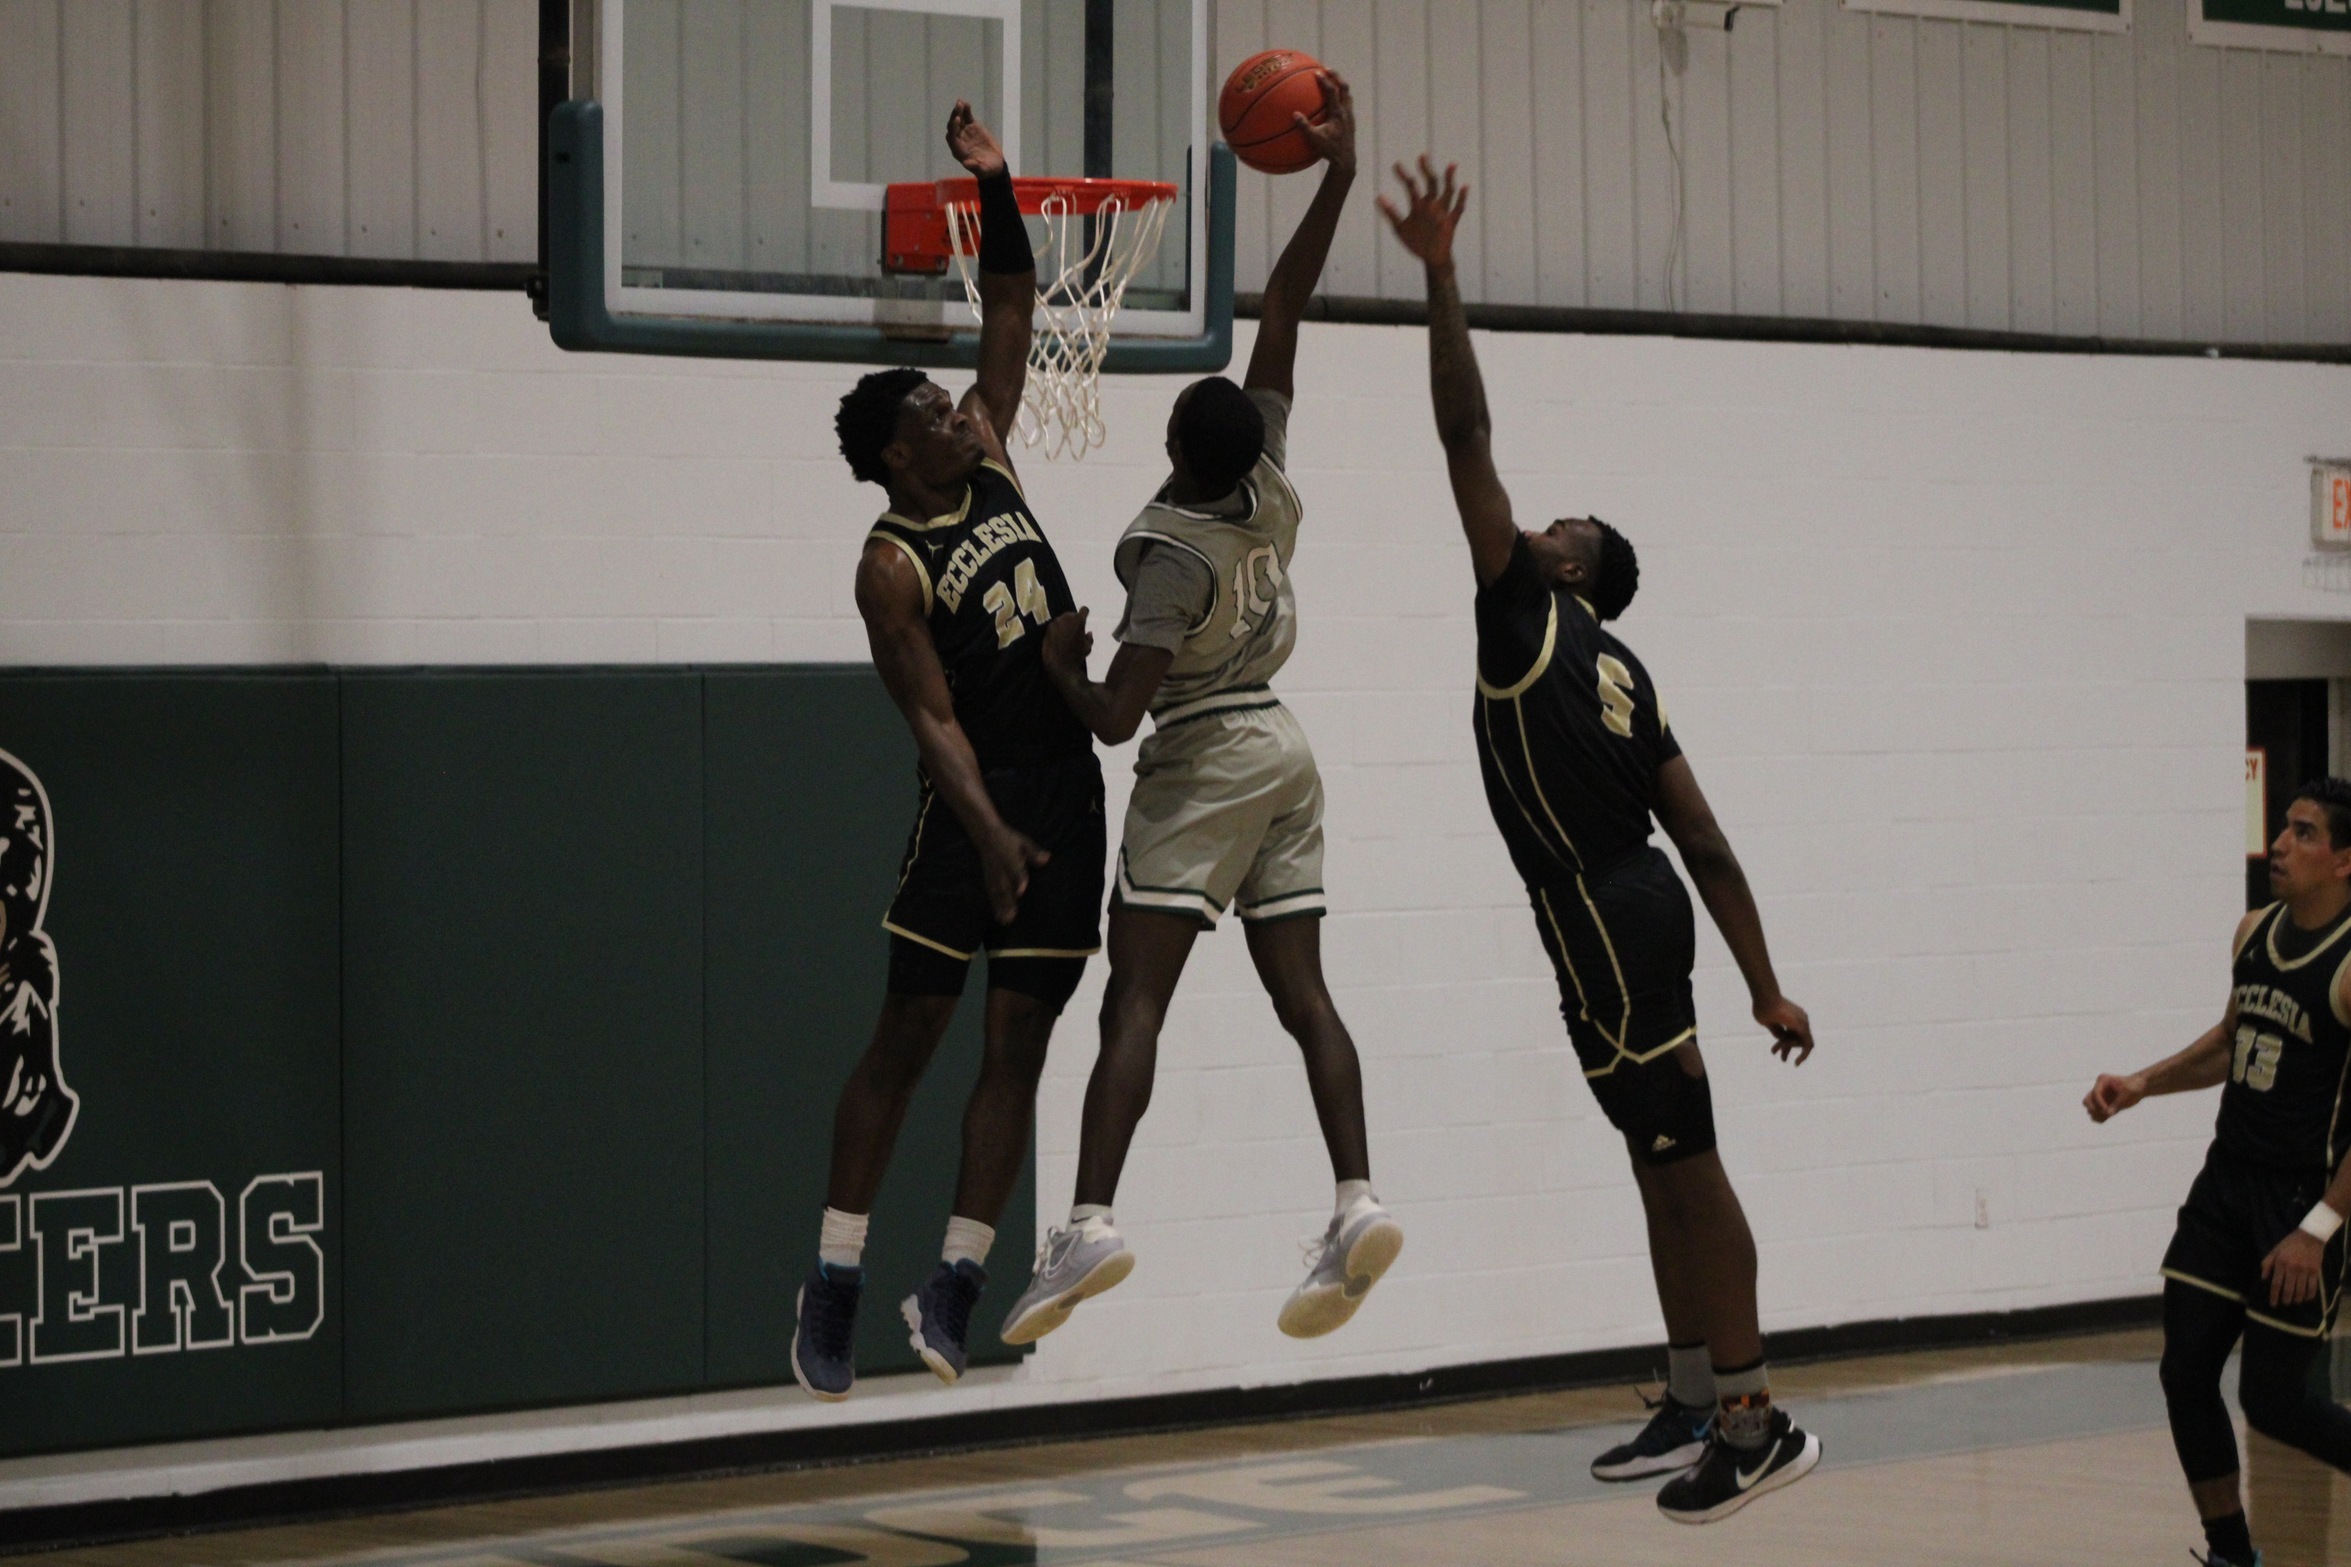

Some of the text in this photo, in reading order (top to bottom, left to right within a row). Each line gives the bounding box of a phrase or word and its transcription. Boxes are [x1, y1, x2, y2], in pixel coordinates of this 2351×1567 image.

[982, 556, 1052, 650] 24
[1229, 542, 1284, 640] 10
[1595, 651, 1635, 739] 5
[2232, 1023, 2283, 1092] 13
